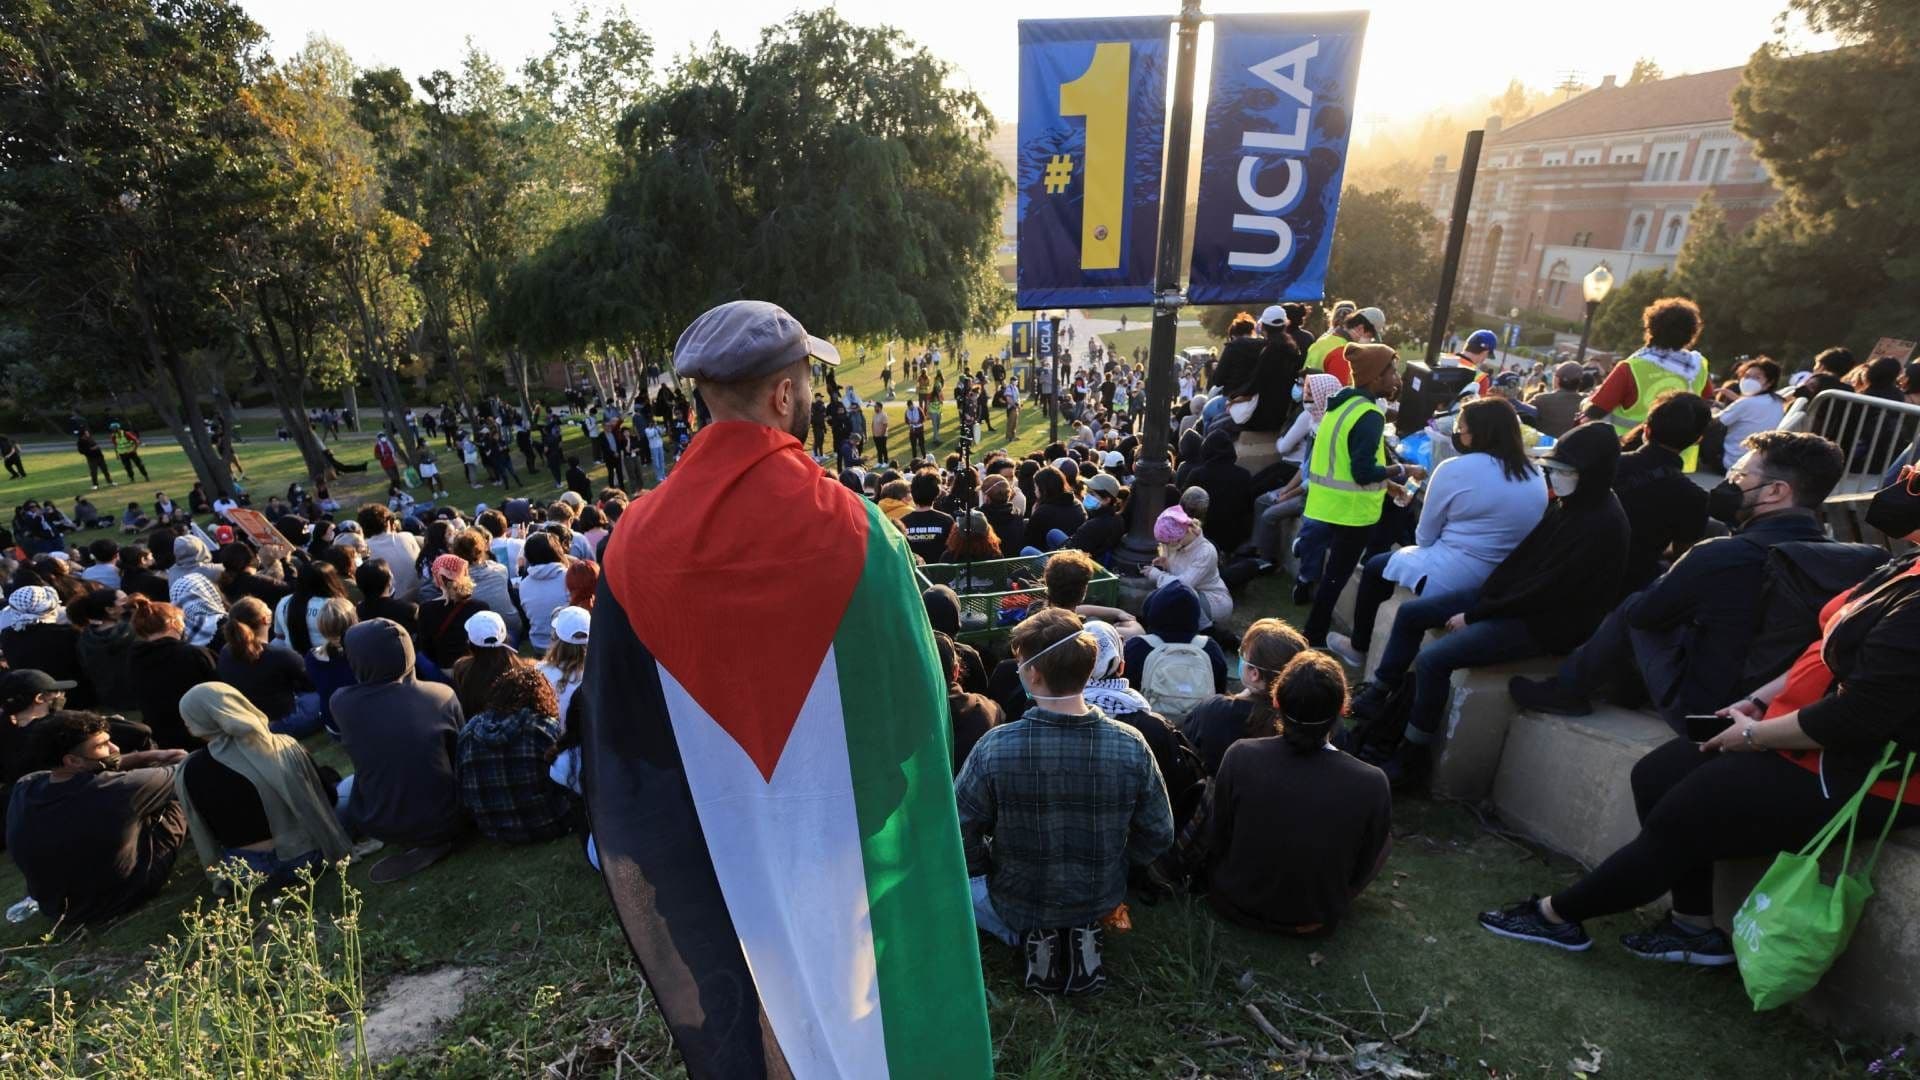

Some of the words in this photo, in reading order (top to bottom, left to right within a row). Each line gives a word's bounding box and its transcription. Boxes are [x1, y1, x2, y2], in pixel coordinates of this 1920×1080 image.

[1044, 42, 1130, 269] #1
[1228, 40, 1319, 269] UCLA
[1041, 323, 1051, 352] UCLA
